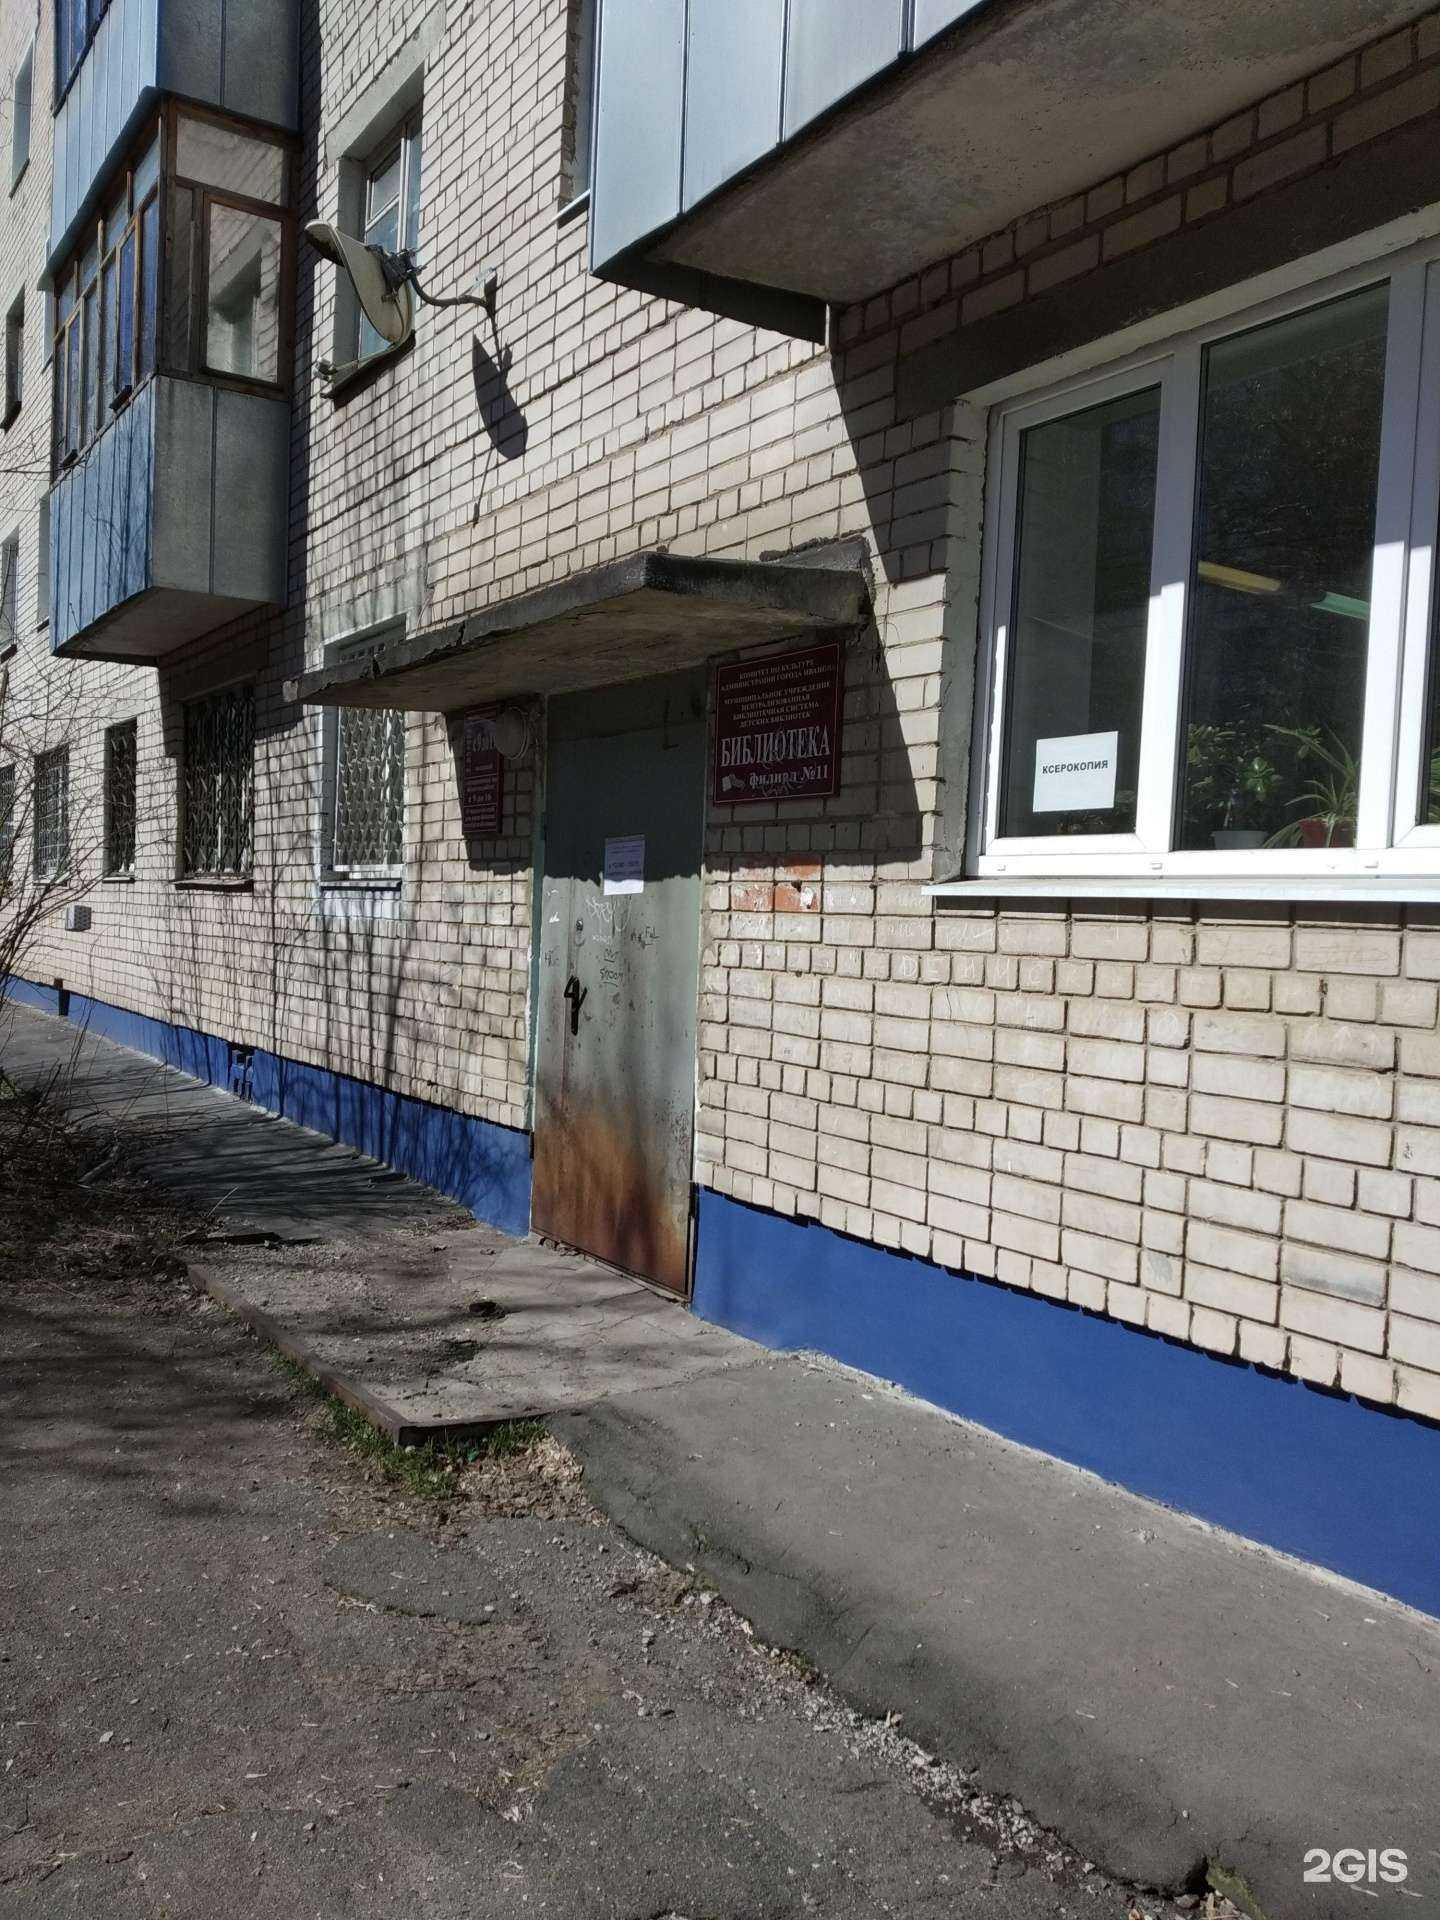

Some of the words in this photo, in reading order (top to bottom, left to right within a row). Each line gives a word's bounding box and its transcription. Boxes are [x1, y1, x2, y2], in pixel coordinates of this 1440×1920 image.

[720, 724, 831, 767] БИБЛИОТЕКА
[749, 771, 798, 789] филиал
[801, 764, 829, 781] №11
[1042, 760, 1108, 774] КСЕРОКОПИЯ
